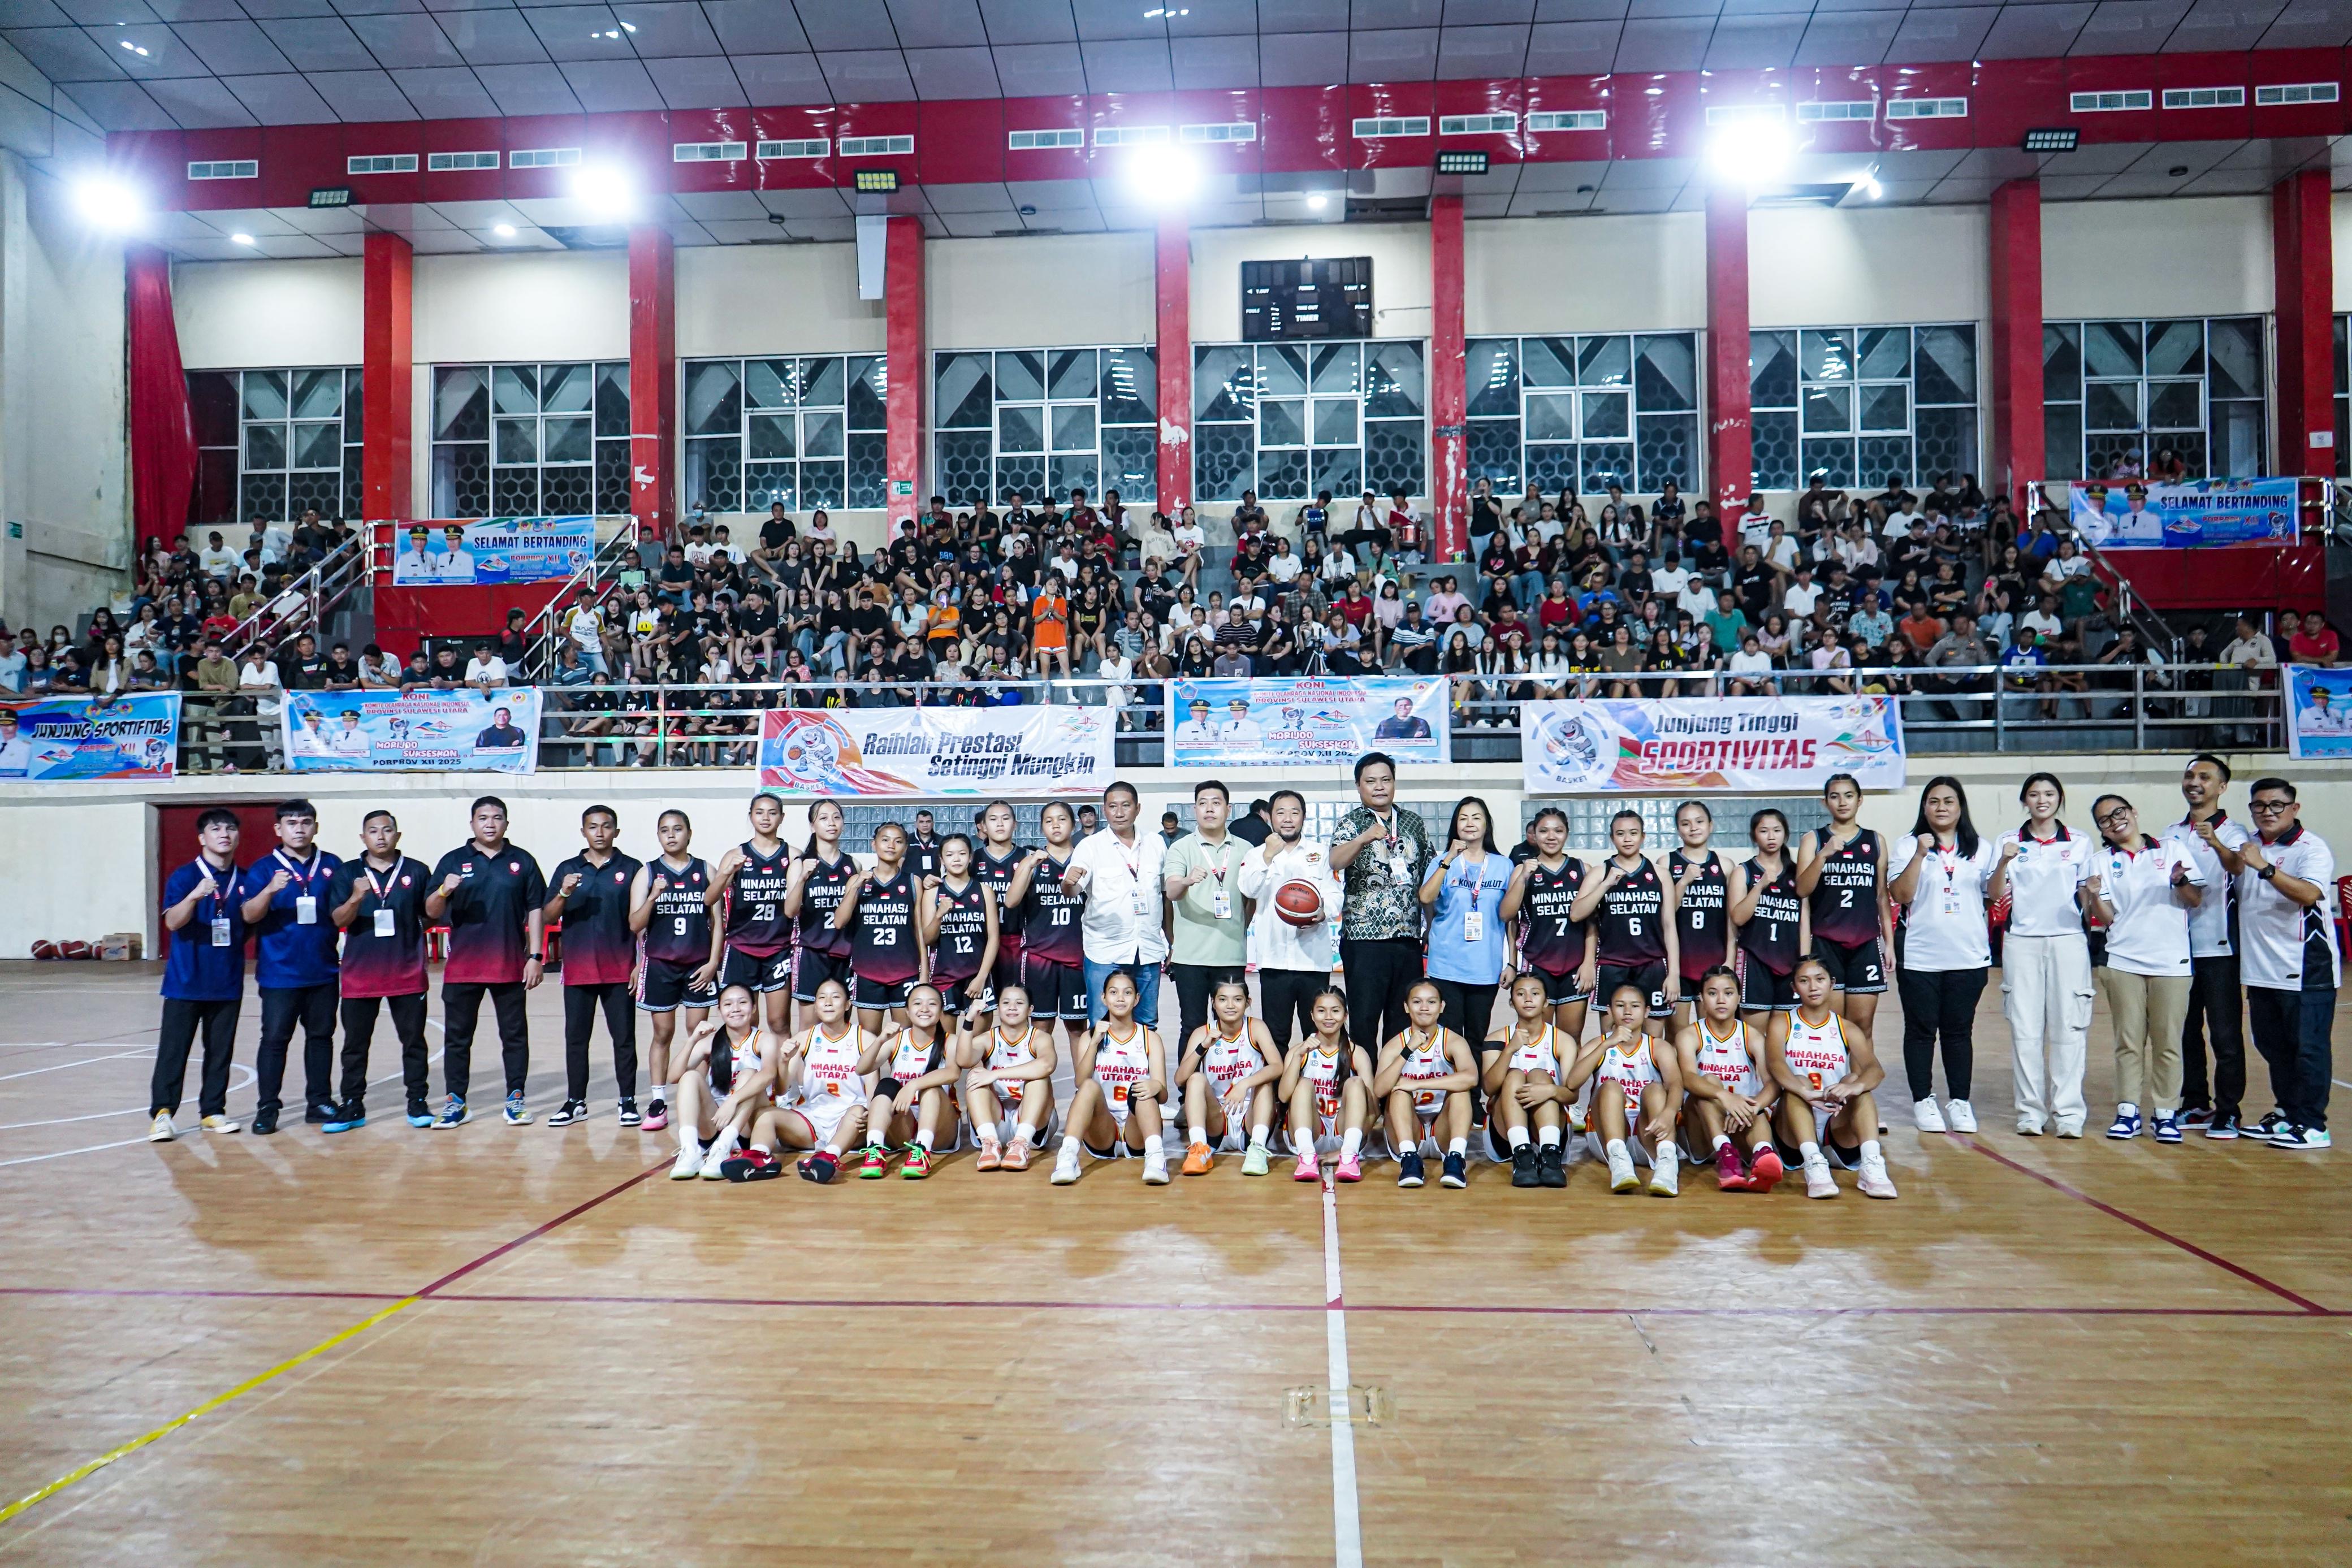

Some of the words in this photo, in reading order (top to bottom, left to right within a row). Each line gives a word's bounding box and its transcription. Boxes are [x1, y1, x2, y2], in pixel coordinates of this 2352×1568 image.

[2160, 496, 2211, 510] SELAMAT
[2217, 495, 2288, 509] BERTANDING
[474, 536, 519, 549] SELAMAT
[524, 536, 587, 548] BERTANDING
[32, 722, 91, 739] JUNJUNG
[93, 719, 172, 738] SPORTIFITAS
[1655, 712, 1732, 735] Junjung
[1737, 712, 1799, 733] Tinggi
[1268, 731, 1314, 740] MARIJOO
[120, 743, 136, 752] XII
[863, 731, 936, 756] Raihlah
[937, 731, 1023, 754] Prestasi
[1640, 738, 1817, 772] SPORTIVITAS
[928, 753, 1007, 780] Setinggi
[1013, 752, 1095, 777] Mungkin
[793, 780, 825, 790] BASKET
[1556, 774, 1588, 784] BASKET
[741, 878, 787, 889] MINAHAS
[1459, 878, 1477, 889] KONI
[1480, 880, 1502, 888] SULUT
[1824, 875, 1873, 887] SELATAN
[743, 890, 787, 902] SELATAN
[809, 885, 846, 898] MINAHA
[1288, 886, 1309, 895] molten
[1532, 889, 1579, 904] MINAHAS
[1685, 885, 1724, 895] NAHASA
[1605, 891, 1661, 903] MINAHASA
[1682, 898, 1723, 908] ELATAN
[1757, 894, 1799, 910] INAHAS
[1840, 889, 1853, 908] 2
[656, 904, 703, 914] SELATAN
[751, 904, 776, 921] 28
[1537, 903, 1571, 916] SELAT
[1610, 903, 1658, 915] SELATAN
[1754, 907, 1799, 923] SELATAN
[863, 915, 907, 925] SELATAN
[940, 911, 985, 922] INAHASA
[1051, 908, 1071, 925] 10
[1692, 911, 1705, 929] 8
[674, 917, 686, 935] 9
[940, 923, 982, 934] SELATAN
[1555, 918, 1568, 936] 7
[1628, 917, 1642, 936] 6
[1770, 923, 1778, 942] 1
[873, 928, 897, 945] 23
[954, 936, 974, 954] 12
[1866, 965, 1879, 981] 2
[1651, 991, 1663, 1006] 6
[1785, 1050, 1845, 1063] MINAHASA
[1093, 1064, 1148, 1076] MINAHASA
[1795, 1059, 1835, 1070] UTARA
[815, 1071, 848, 1080] UTARA
[1102, 1073, 1138, 1082] UTARA
[1113, 1085, 1128, 1102] 6
